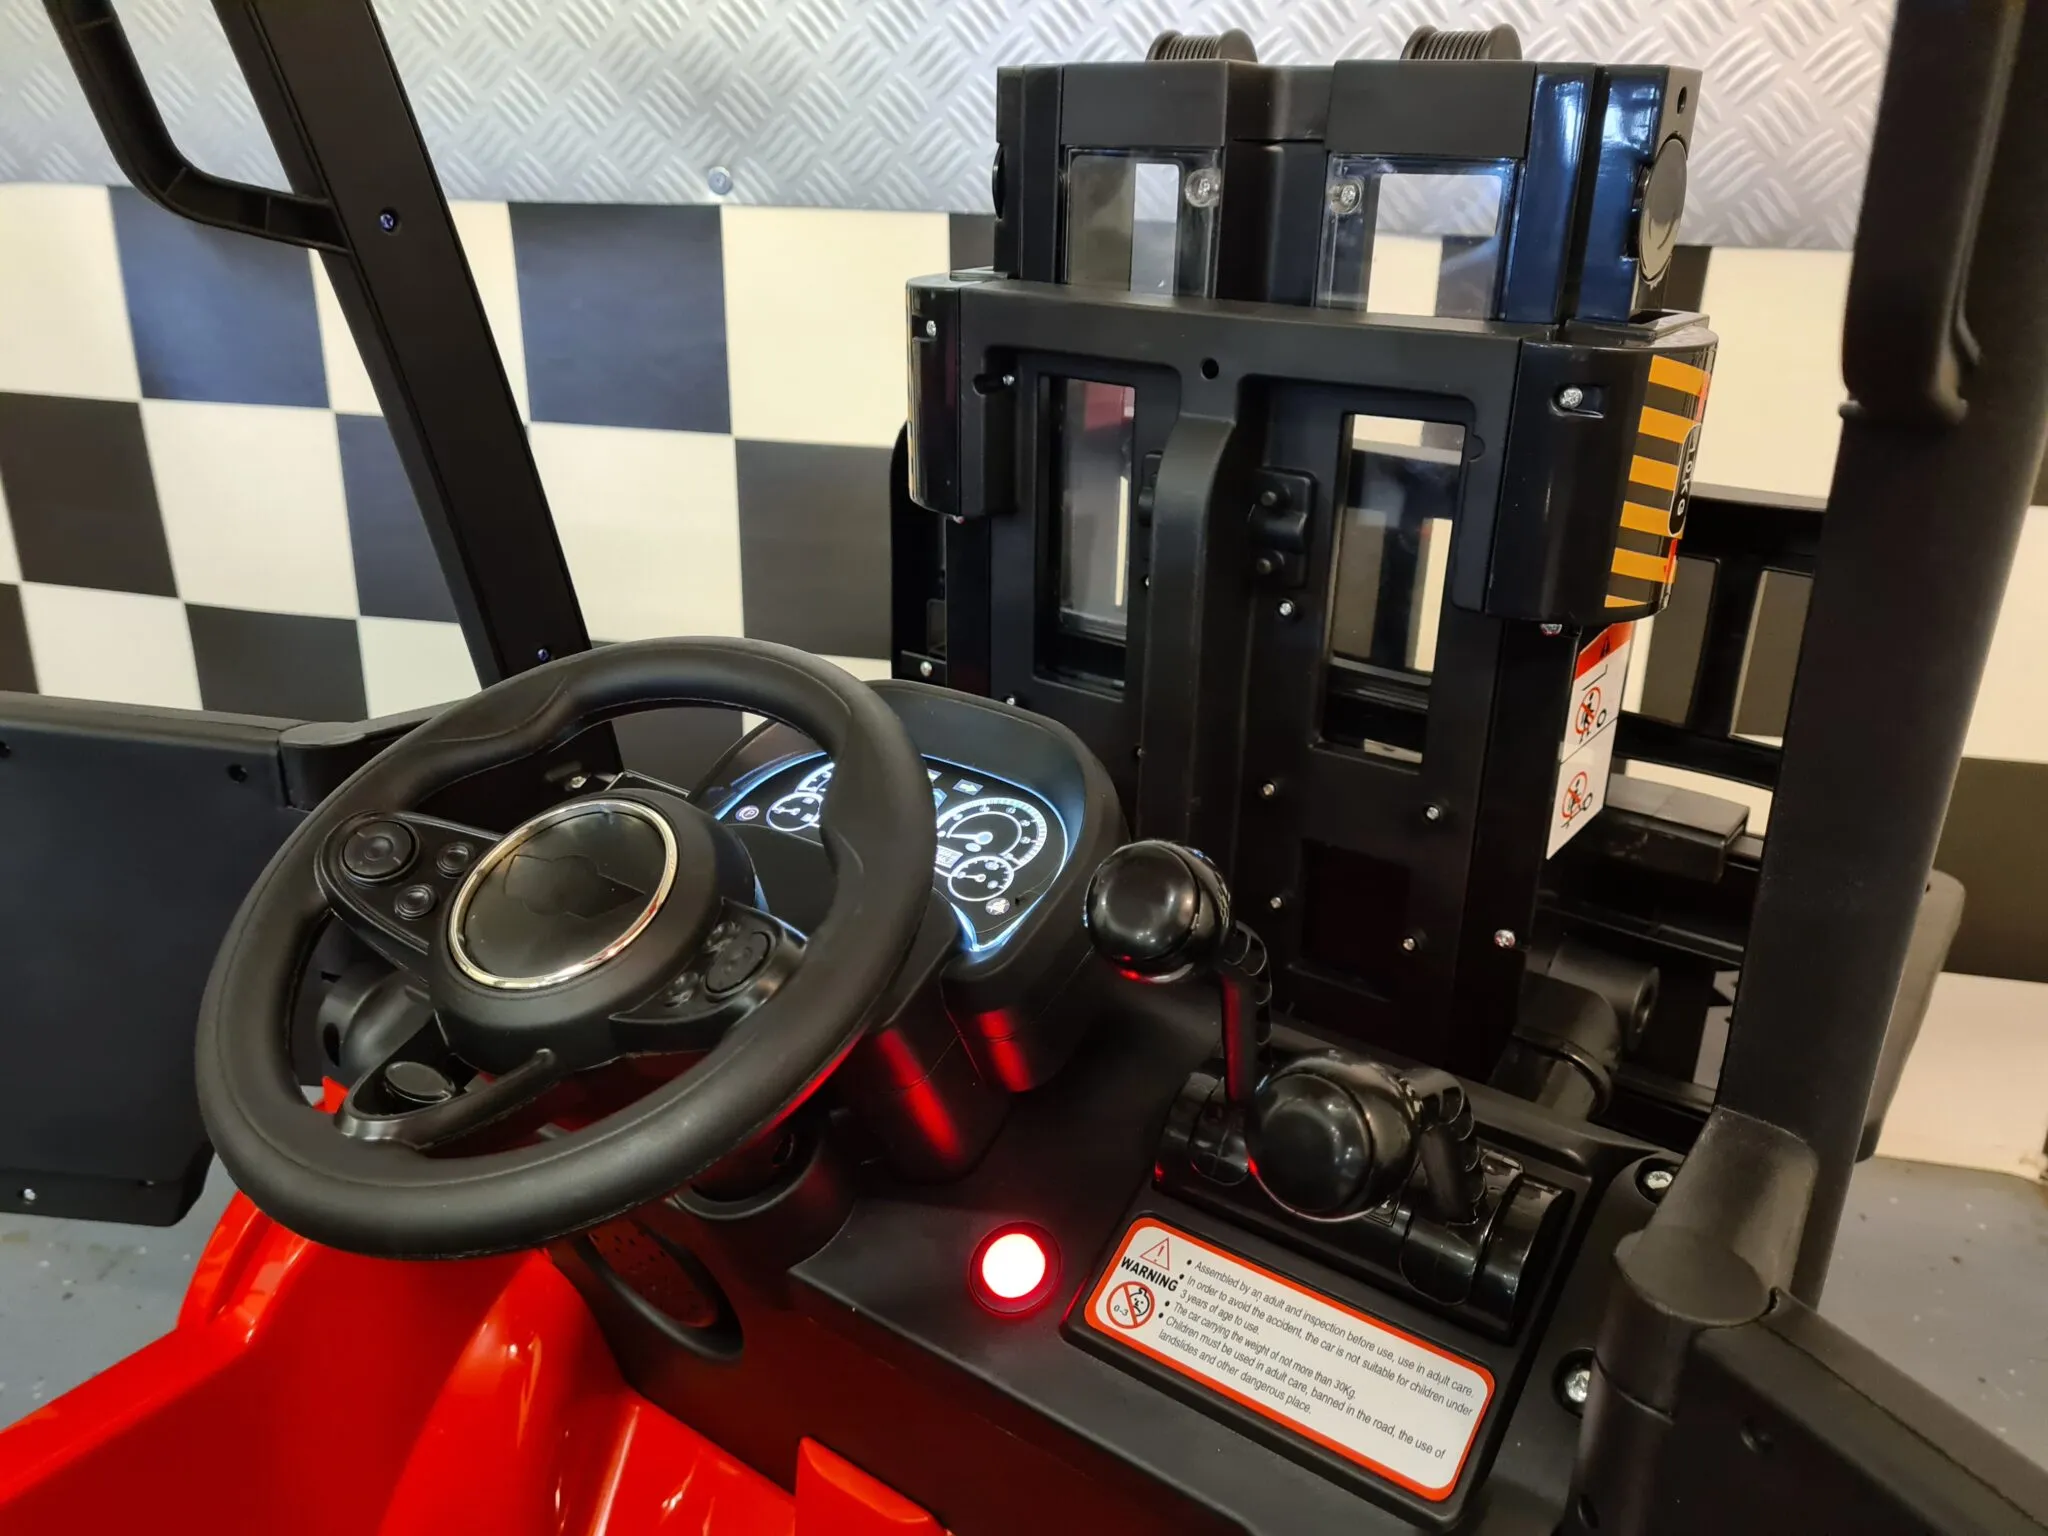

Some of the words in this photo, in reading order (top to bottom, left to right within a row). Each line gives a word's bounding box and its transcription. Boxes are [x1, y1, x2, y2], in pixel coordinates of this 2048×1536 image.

[1113, 1304, 1129, 1317] 0-3
[1121, 1256, 1178, 1292] WARNING
[1179, 1289, 1188, 1299] 3
[1185, 1294, 1209, 1310] years
[1208, 1304, 1219, 1314] of
[1217, 1309, 1234, 1322] age
[1234, 1315, 1243, 1326] to
[1243, 1321, 1259, 1335] use.
[1158, 1329, 1199, 1356] landslides
[1198, 1351, 1218, 1365] and
[1216, 1360, 1240, 1376] other
[1240, 1371, 1286, 1401] dangerous
[1284, 1394, 1311, 1414] place.
[1173, 1301, 1188, 1317] The
[1188, 1311, 1202, 1323] car
[1200, 1317, 1231, 1340] carrying
[1230, 1330, 1244, 1344] the
[1244, 1338, 1270, 1357] weight
[1269, 1351, 1280, 1361] of
[1278, 1355, 1293, 1368] not
[1292, 1362, 1314, 1378] more
[1314, 1371, 1333, 1388] than
[1333, 1379, 1356, 1401] 30Kg.
[1187, 1275, 1196, 1287] In
[1196, 1282, 1219, 1297] order
[1218, 1290, 1228, 1302] to
[1227, 1296, 1253, 1313] avoid
[1251, 1306, 1265, 1320] the
[1265, 1314, 1303, 1339] accident,
[1304, 1331, 1320, 1345] the
[1320, 1340, 1336, 1352] car
[1335, 1345, 1345, 1357] is
[1344, 1352, 1361, 1365] not
[1361, 1359, 1395, 1381] suitable
[1396, 1373, 1410, 1387] for
[1409, 1381, 1445, 1405] children
[1446, 1398, 1473, 1416] under
[1194, 1261, 1241, 1288] Assembled
[1239, 1280, 1252, 1295] by
[1250, 1288, 1263, 1303] an
[1262, 1294, 1285, 1310] adult
[1284, 1304, 1303, 1318] and
[1302, 1310, 1346, 1338] inspection
[1346, 1330, 1376, 1352] before
[1376, 1346, 1395, 1363] use,
[1397, 1356, 1415, 1370] use
[1415, 1362, 1426, 1375] in
[1426, 1369, 1451, 1387] adult
[1451, 1381, 1473, 1398] care.
[1165, 1315, 1199, 1340] Children
[1199, 1334, 1222, 1350] must
[1220, 1342, 1233, 1356] be
[1233, 1350, 1257, 1367] used
[1255, 1359, 1265, 1372] in
[1264, 1366, 1288, 1383] adult
[1287, 1377, 1308, 1396] care,
[1310, 1386, 1346, 1411] banned
[1345, 1403, 1355, 1416] in
[1356, 1409, 1372, 1424] the
[1372, 1419, 1396, 1438] road,
[1398, 1429, 1414, 1445] the
[1415, 1439, 1433, 1454] use
[1434, 1449, 1447, 1459] of
